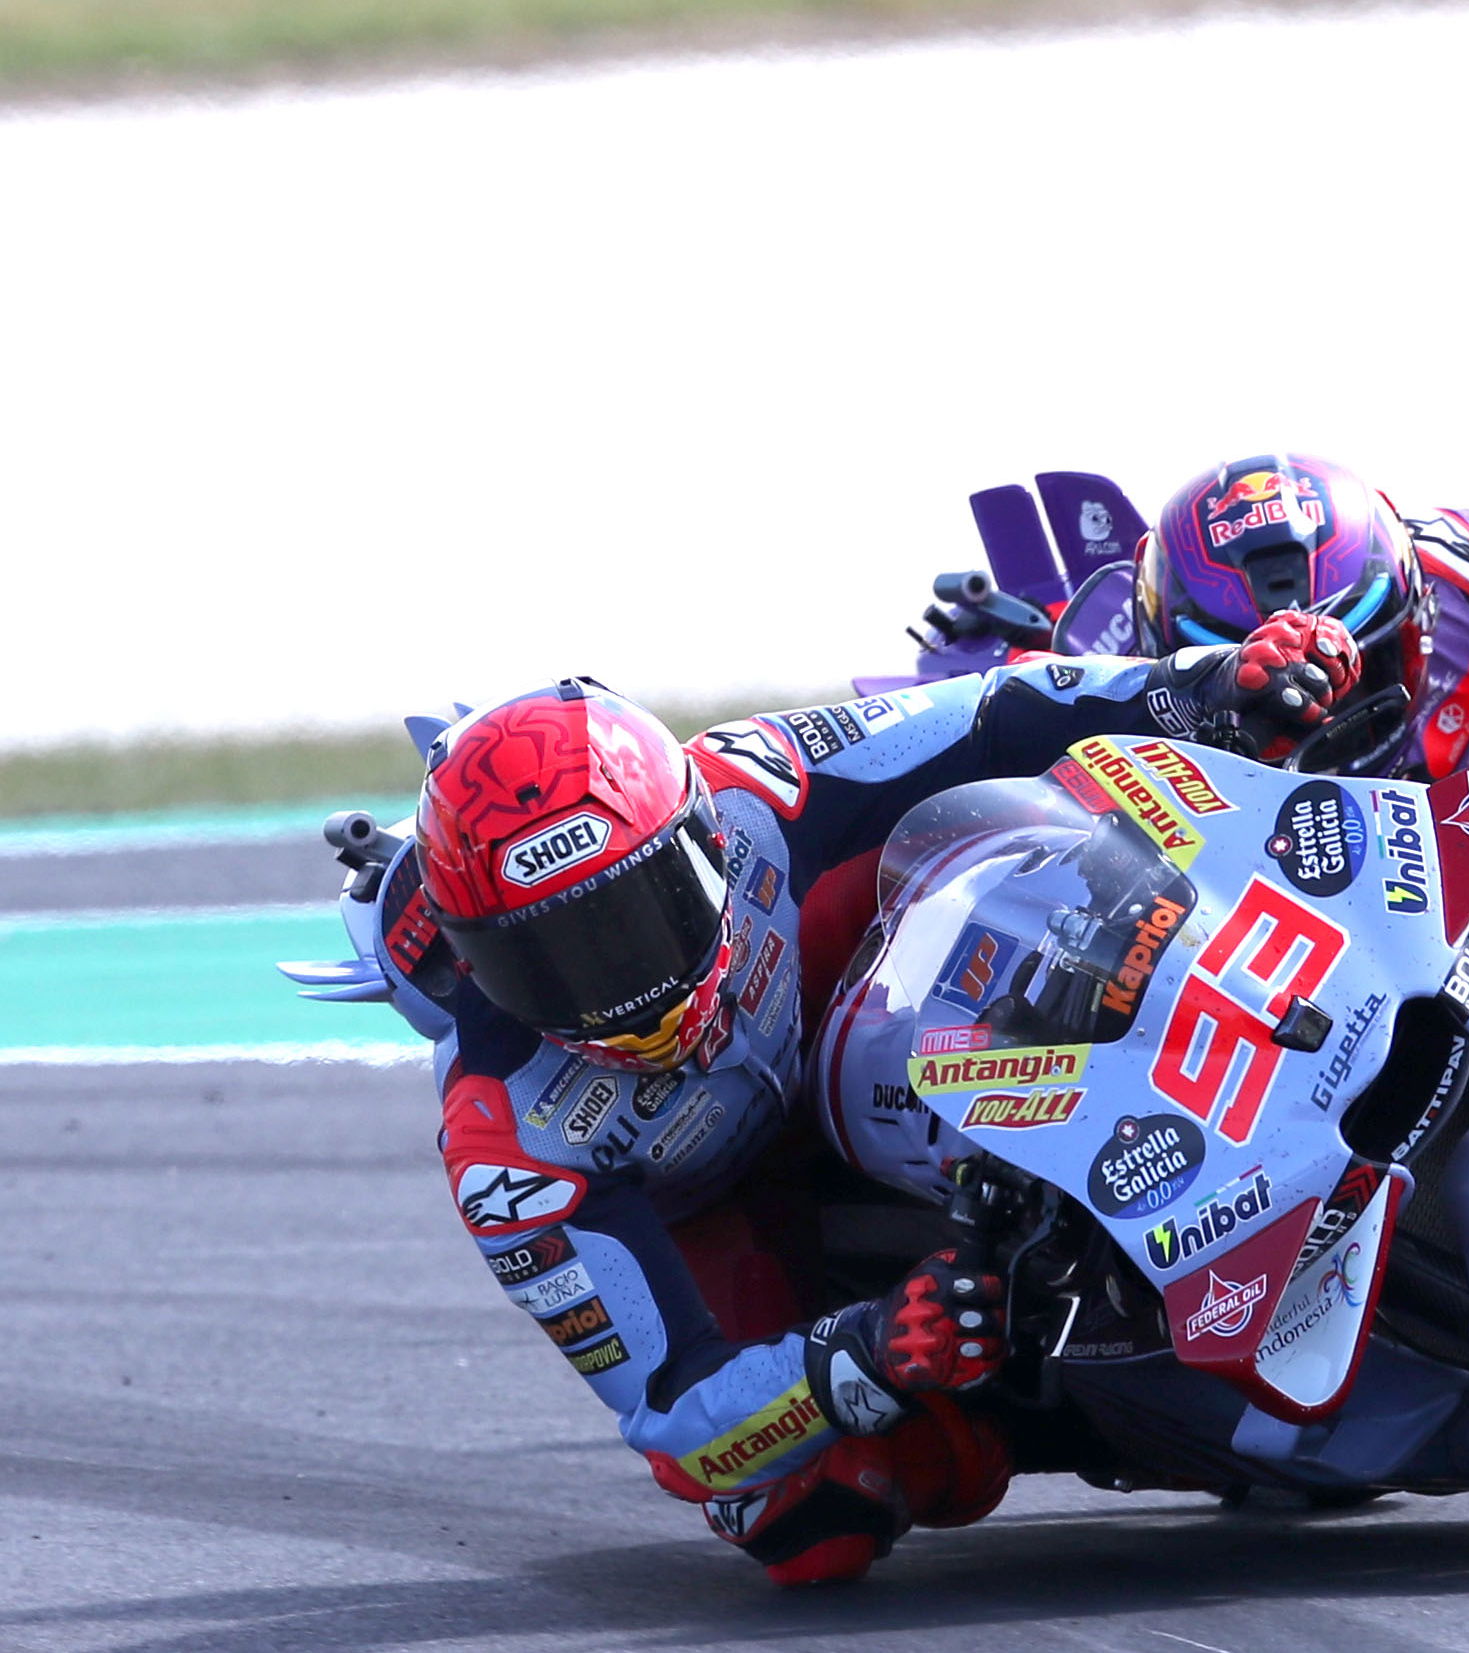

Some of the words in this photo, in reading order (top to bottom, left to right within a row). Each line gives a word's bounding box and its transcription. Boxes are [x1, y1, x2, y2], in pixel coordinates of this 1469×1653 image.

[1209, 502, 1266, 547] Red
[1264, 500, 1325, 525] Bll
[789, 713, 829, 760] BOLD
[1081, 741, 1195, 851] Antangin
[514, 821, 600, 878] SHOEI
[1292, 801, 1322, 880] Estrella
[1319, 799, 1345, 874] Galicia
[1381, 788, 1429, 914] Unibat
[498, 902, 552, 928] GIVES
[560, 876, 598, 906] YOU
[604, 836, 664, 880] WINGS
[1101, 896, 1187, 1015] Kapriol
[602, 976, 681, 1019] VERTICAL
[1152, 874, 1349, 1146] 93
[918, 1050, 1076, 1090] Antangin
[1311, 992, 1388, 1112] Gigetta
[568, 1080, 615, 1139] SHOEI
[970, 1088, 1078, 1124] YOU-ALL
[1101, 1125, 1181, 1186] Estrella
[1113, 1151, 1188, 1203] Galicia
[1145, 1175, 1272, 1270] Unibat
[543, 1282, 587, 1308] LUNA
[1190, 1292, 1241, 1333] FEDERAL
[1241, 1281, 1263, 1301] OIL
